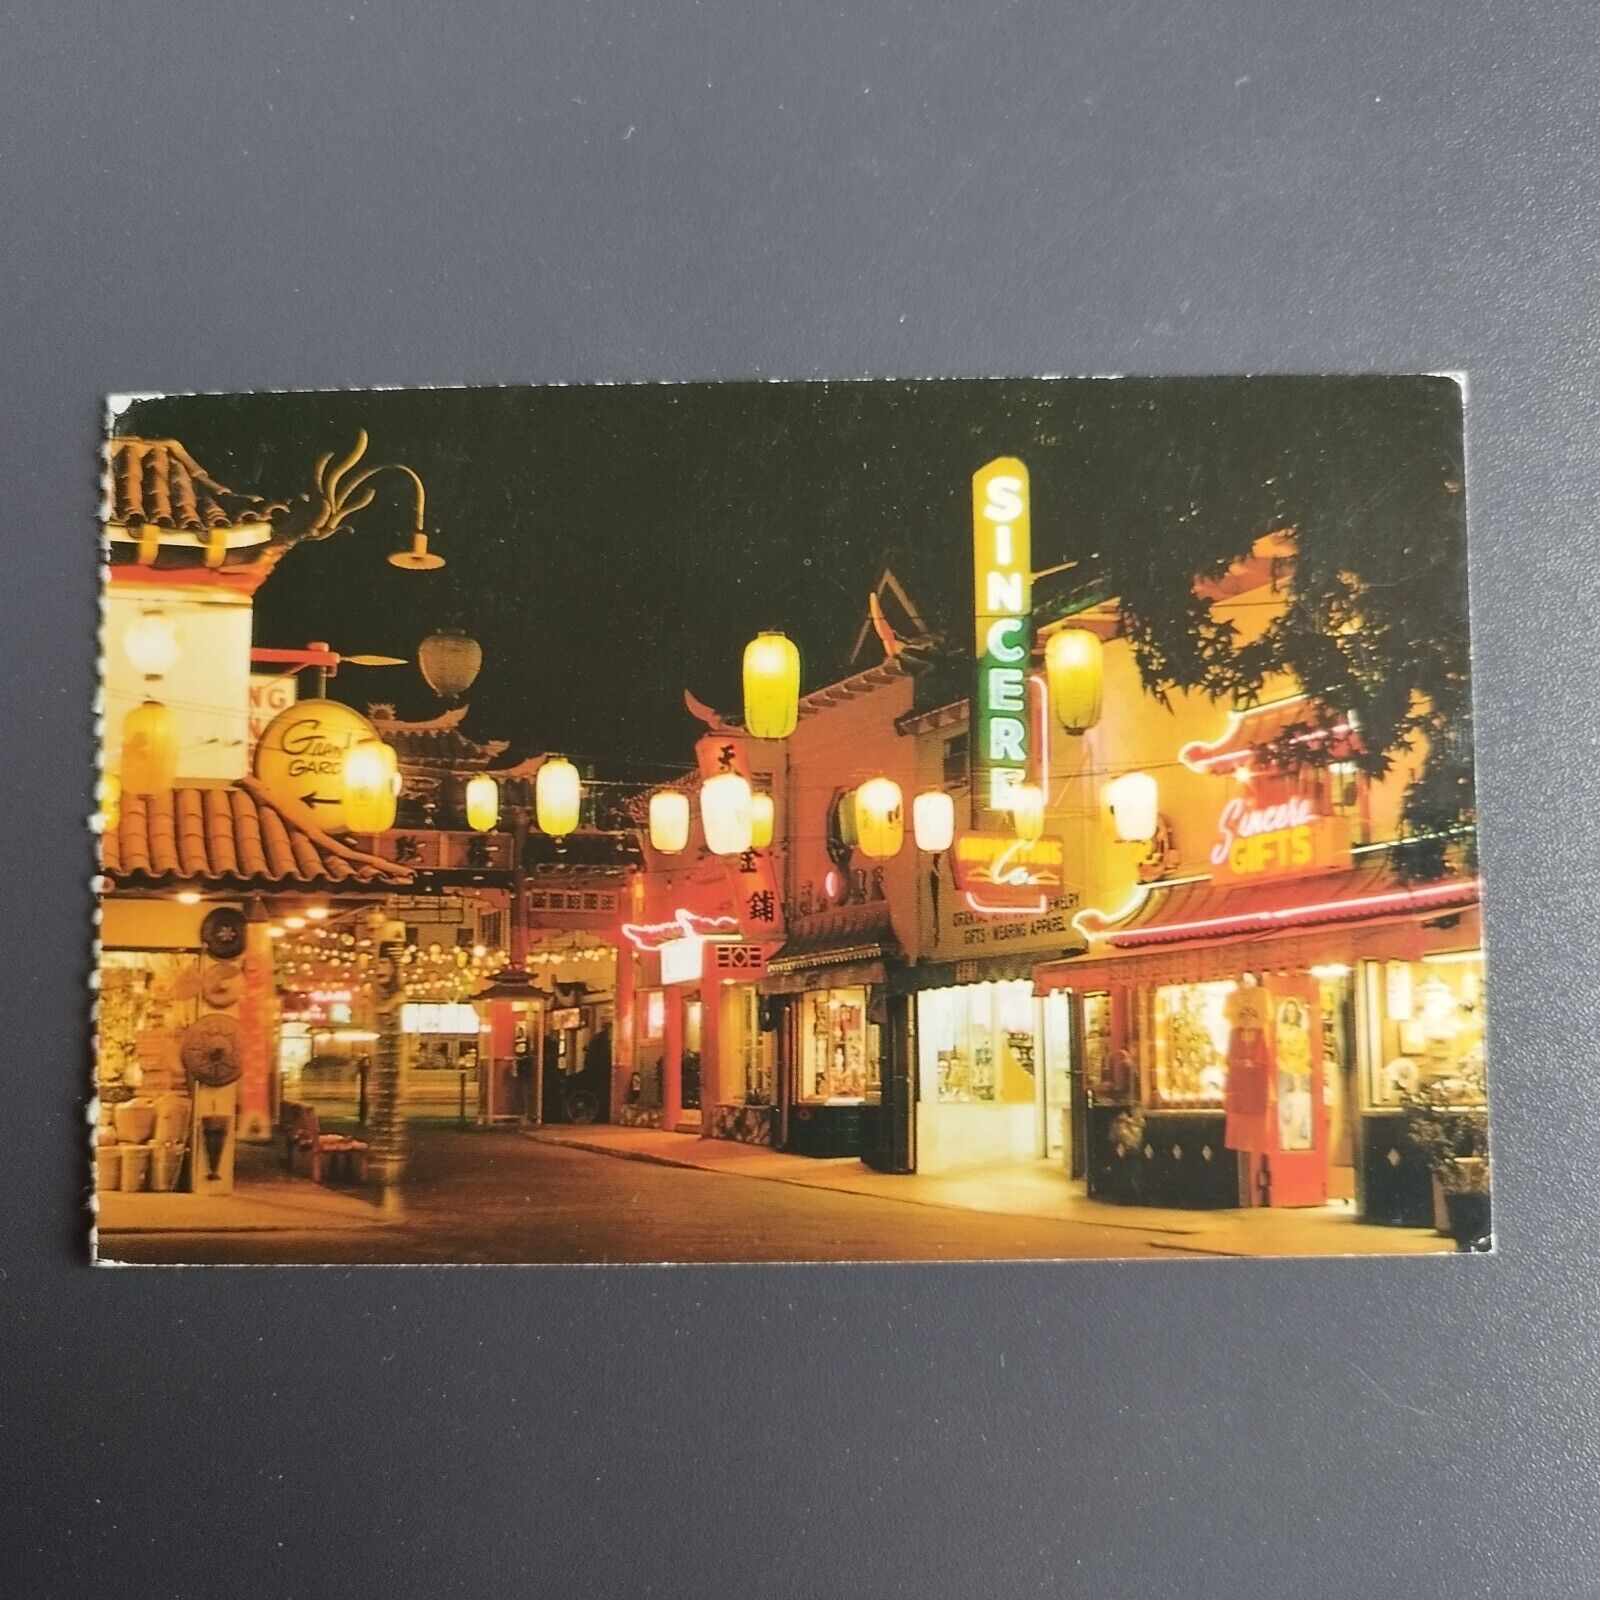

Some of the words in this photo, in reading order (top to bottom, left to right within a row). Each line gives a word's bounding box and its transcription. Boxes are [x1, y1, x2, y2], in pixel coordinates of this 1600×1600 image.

[983, 476, 1027, 810] SINCERE
[281, 719, 354, 756] Grand
[288, 759, 343, 777] GARD
[1211, 797, 1319, 865] Sincere
[1229, 825, 1312, 874] GIFTS
